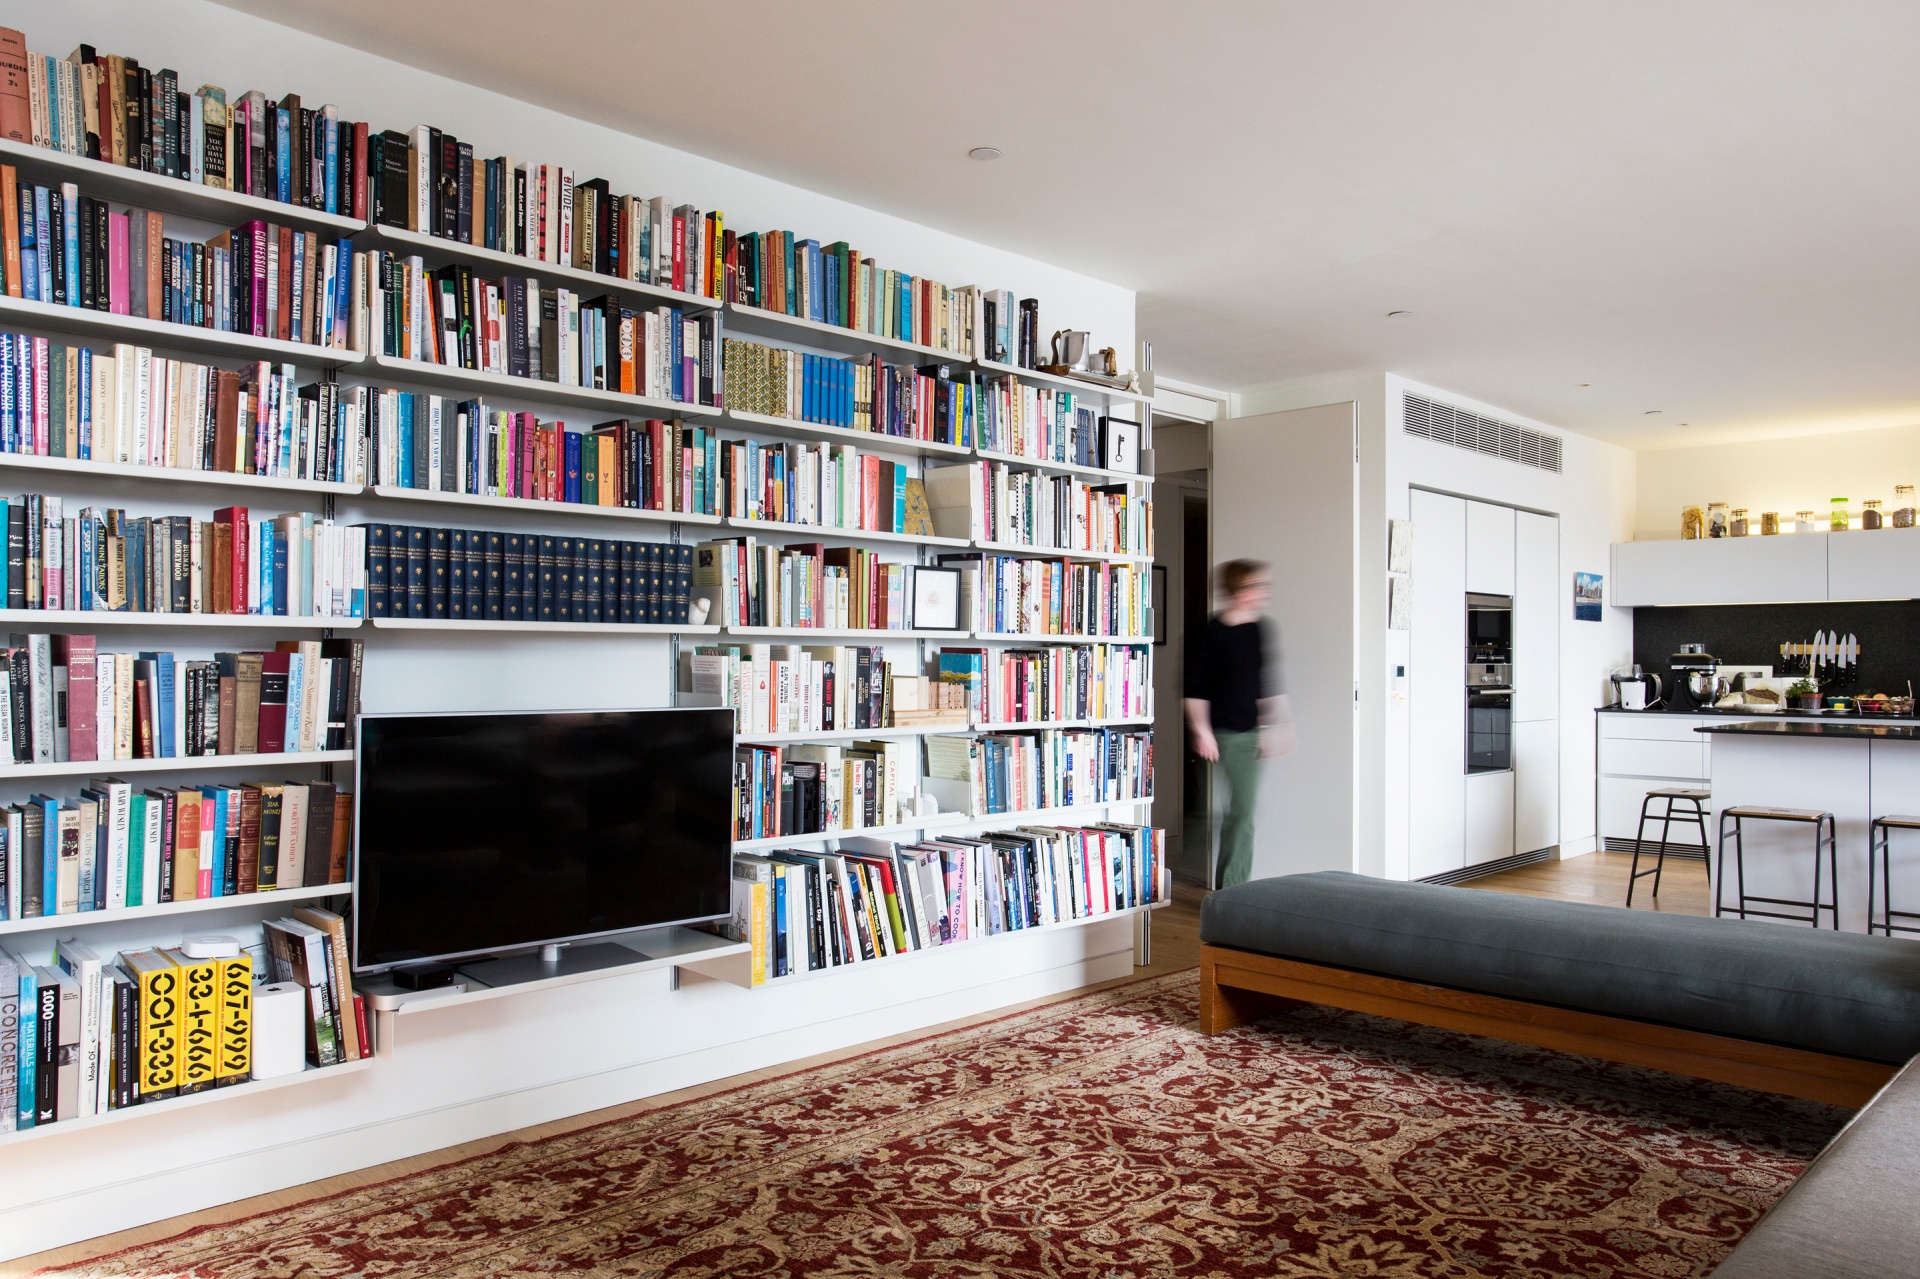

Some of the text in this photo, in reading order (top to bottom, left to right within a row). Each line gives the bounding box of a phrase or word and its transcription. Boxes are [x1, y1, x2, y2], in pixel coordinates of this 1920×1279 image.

[255, 230, 266, 278] CONFESSION
[292, 259, 302, 320] GENEROUS DEATH
[663, 312, 671, 336] Agatha
[0, 336, 14, 411] ANN PURSER
[17, 340, 31, 412] ANN PURSER
[34, 342, 49, 415] ANN PURSER
[285, 378, 294, 406] Gillian Roberts
[98, 564, 107, 590] TAILORS
[182, 544, 190, 577] BUSMAN'S
[36, 642, 45, 685] Wakefield Hall
[1079, 650, 1087, 671] Nigel
[102, 661, 111, 707] Love, Nina
[295, 663, 303, 700] CONFEDERACY
[18, 692, 26, 723] FRANCESCA
[295, 701, 301, 709] OF
[305, 686, 315, 715] Summer
[1, 719, 9, 742] MIDWINTER
[303, 720, 313, 741] Katya
[117, 789, 126, 832] MARY WESLEY
[150, 805, 158, 844] MARY WESLEY
[229, 793, 238, 835] Until DEATH
[47, 820, 55, 872] GRADUATE
[85, 858, 91, 867] OF
[289, 837, 298, 863] AMBER
[868, 891, 878, 914] Material
[955, 904, 961, 915] TO
[952, 917, 960, 940] COOK
[43, 990, 54, 1020] 1000
[188, 968, 213, 1078] 334-666
[224, 964, 249, 1070] 667-999
[26, 1021, 35, 1068] MATERIALS
[149, 973, 175, 1086] 001-333
[1, 1003, 17, 1095] CONCRETE
